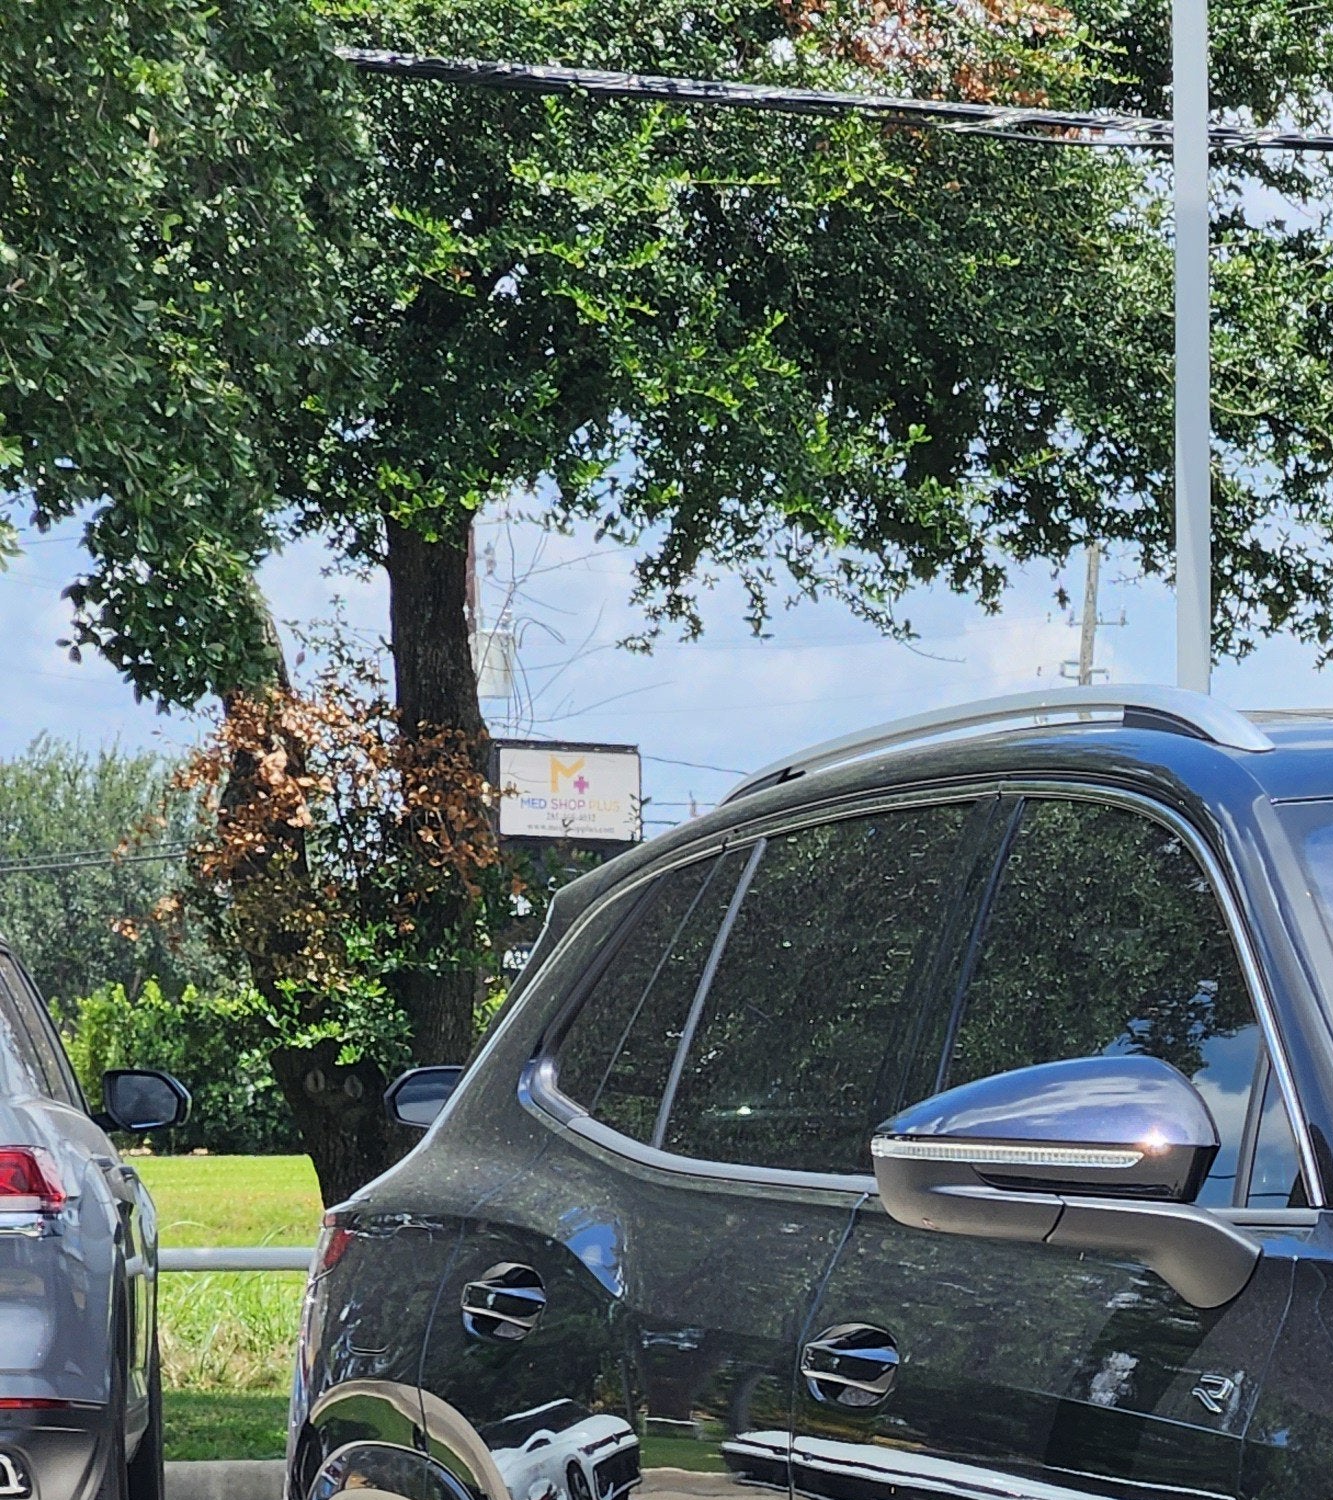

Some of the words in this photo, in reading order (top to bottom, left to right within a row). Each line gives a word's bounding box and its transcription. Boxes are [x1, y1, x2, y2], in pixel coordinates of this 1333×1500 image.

[521, 798, 547, 809] MED
[551, 799, 586, 810] SHOP
[589, 800, 620, 812] PLUS
